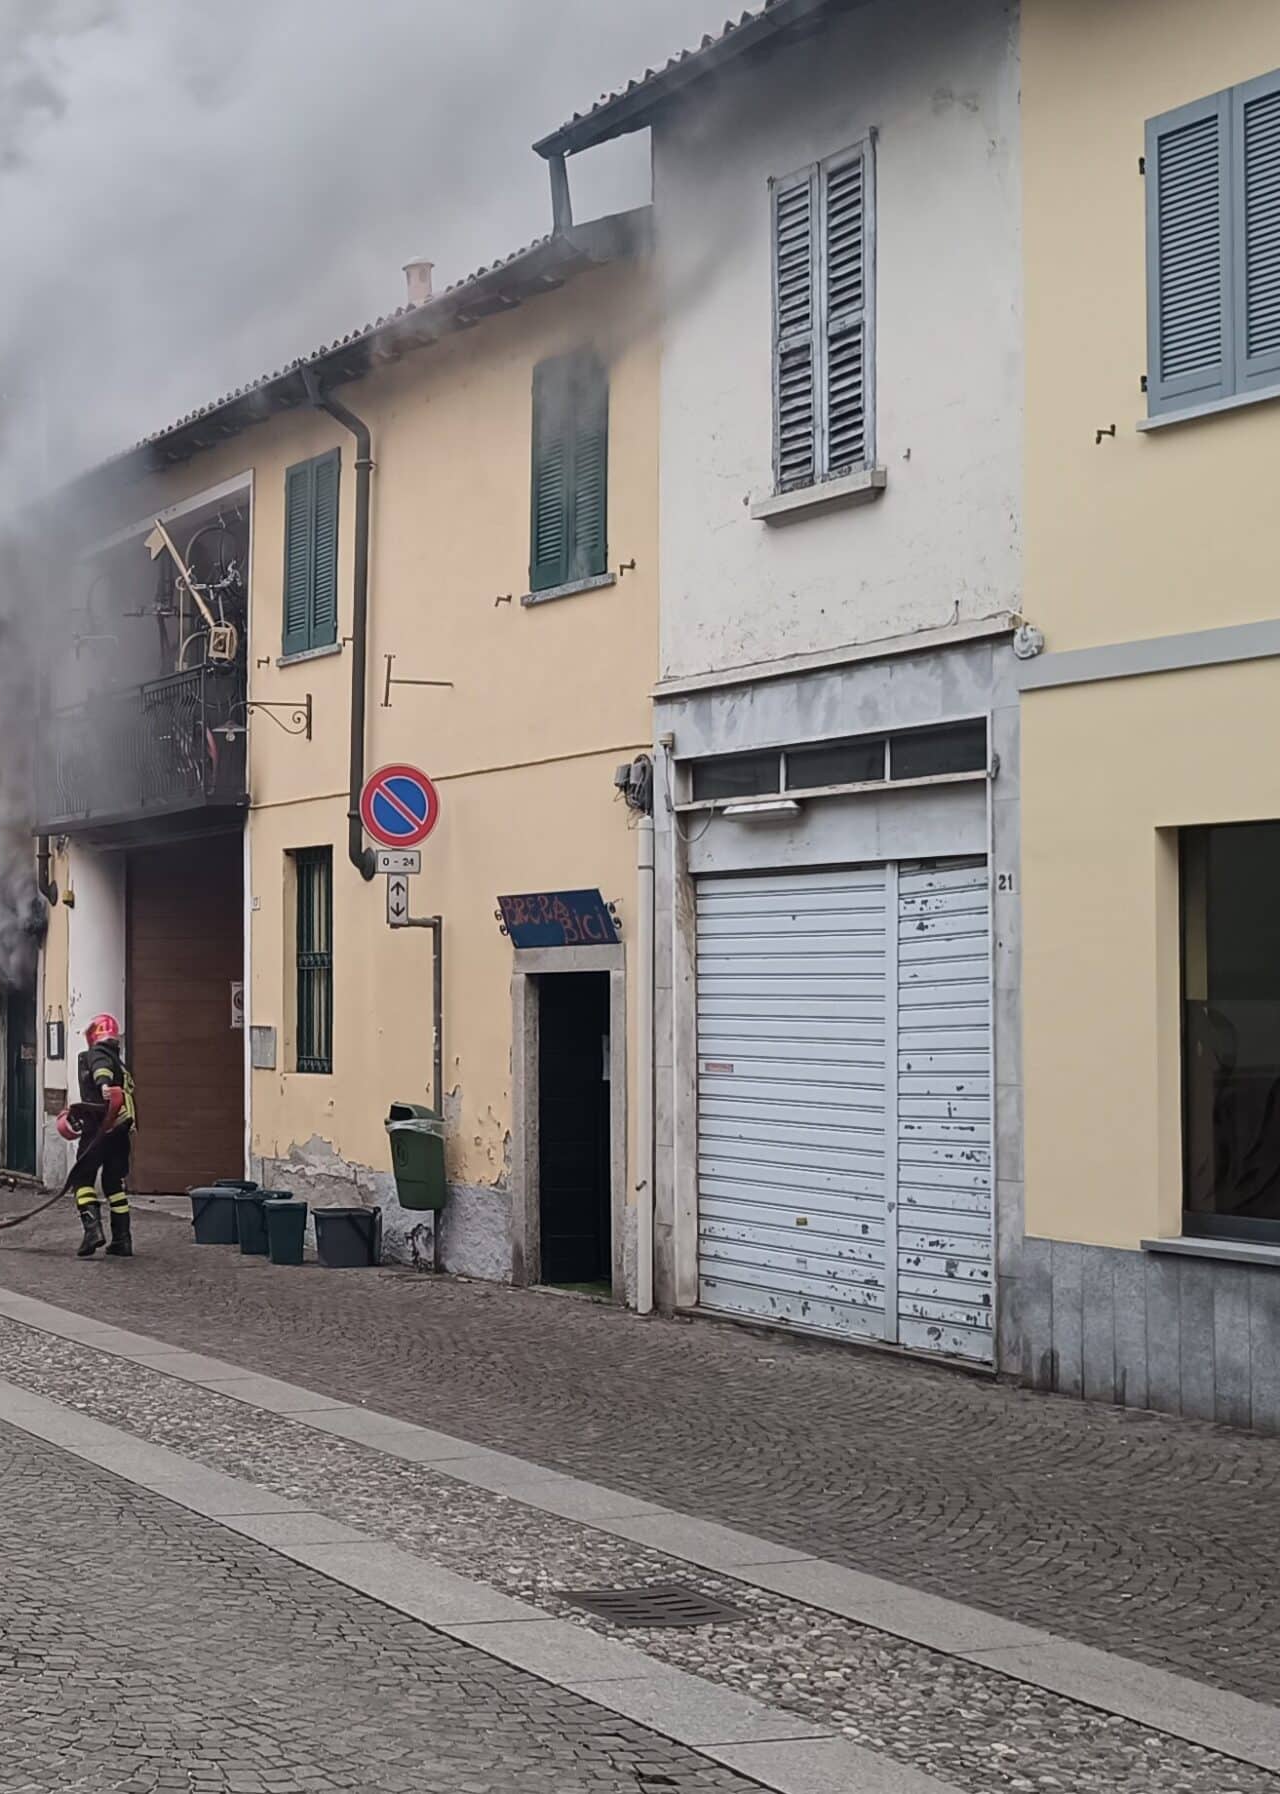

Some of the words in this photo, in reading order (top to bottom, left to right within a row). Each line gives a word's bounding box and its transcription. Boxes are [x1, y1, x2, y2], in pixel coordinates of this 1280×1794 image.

[383, 857, 390, 866] 0
[402, 857, 415, 866] 24
[998, 873, 1013, 891] 21
